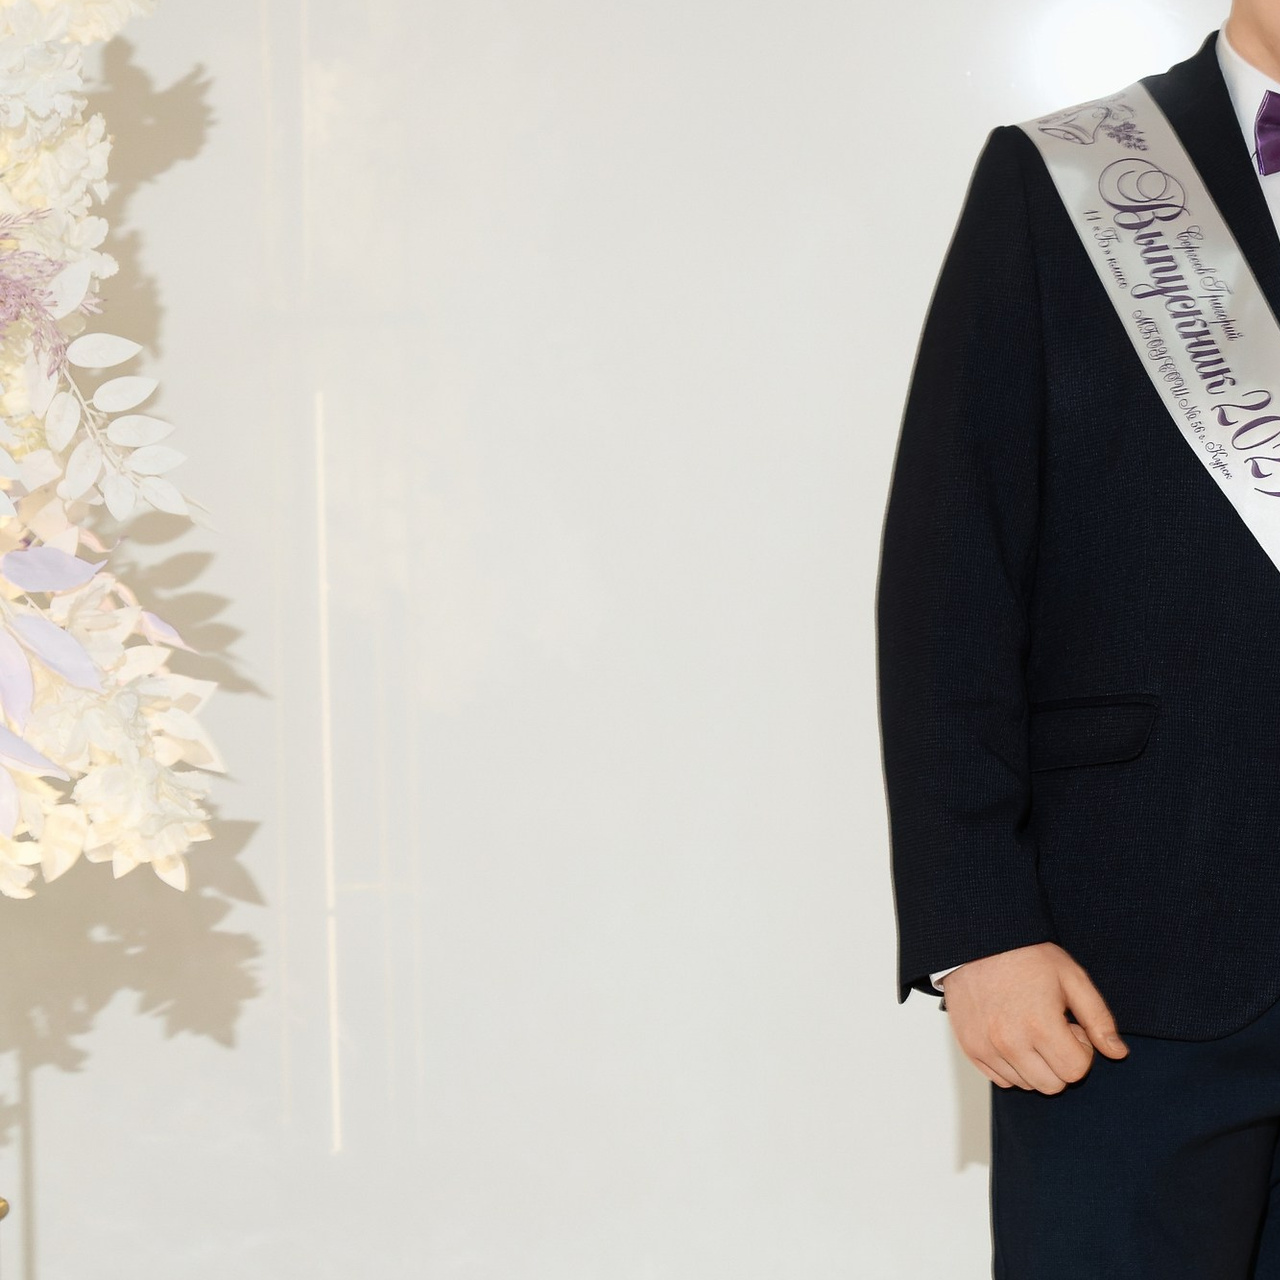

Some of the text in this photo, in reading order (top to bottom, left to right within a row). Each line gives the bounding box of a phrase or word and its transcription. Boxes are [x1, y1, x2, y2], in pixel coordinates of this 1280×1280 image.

[1098, 157, 1237, 395] Выпускник
[1173, 225, 1244, 341] Сергеев Григорий
[1178, 399, 1201, 421] №
[1190, 421, 1206, 434] 56
[1205, 442, 1233, 480] Курск
